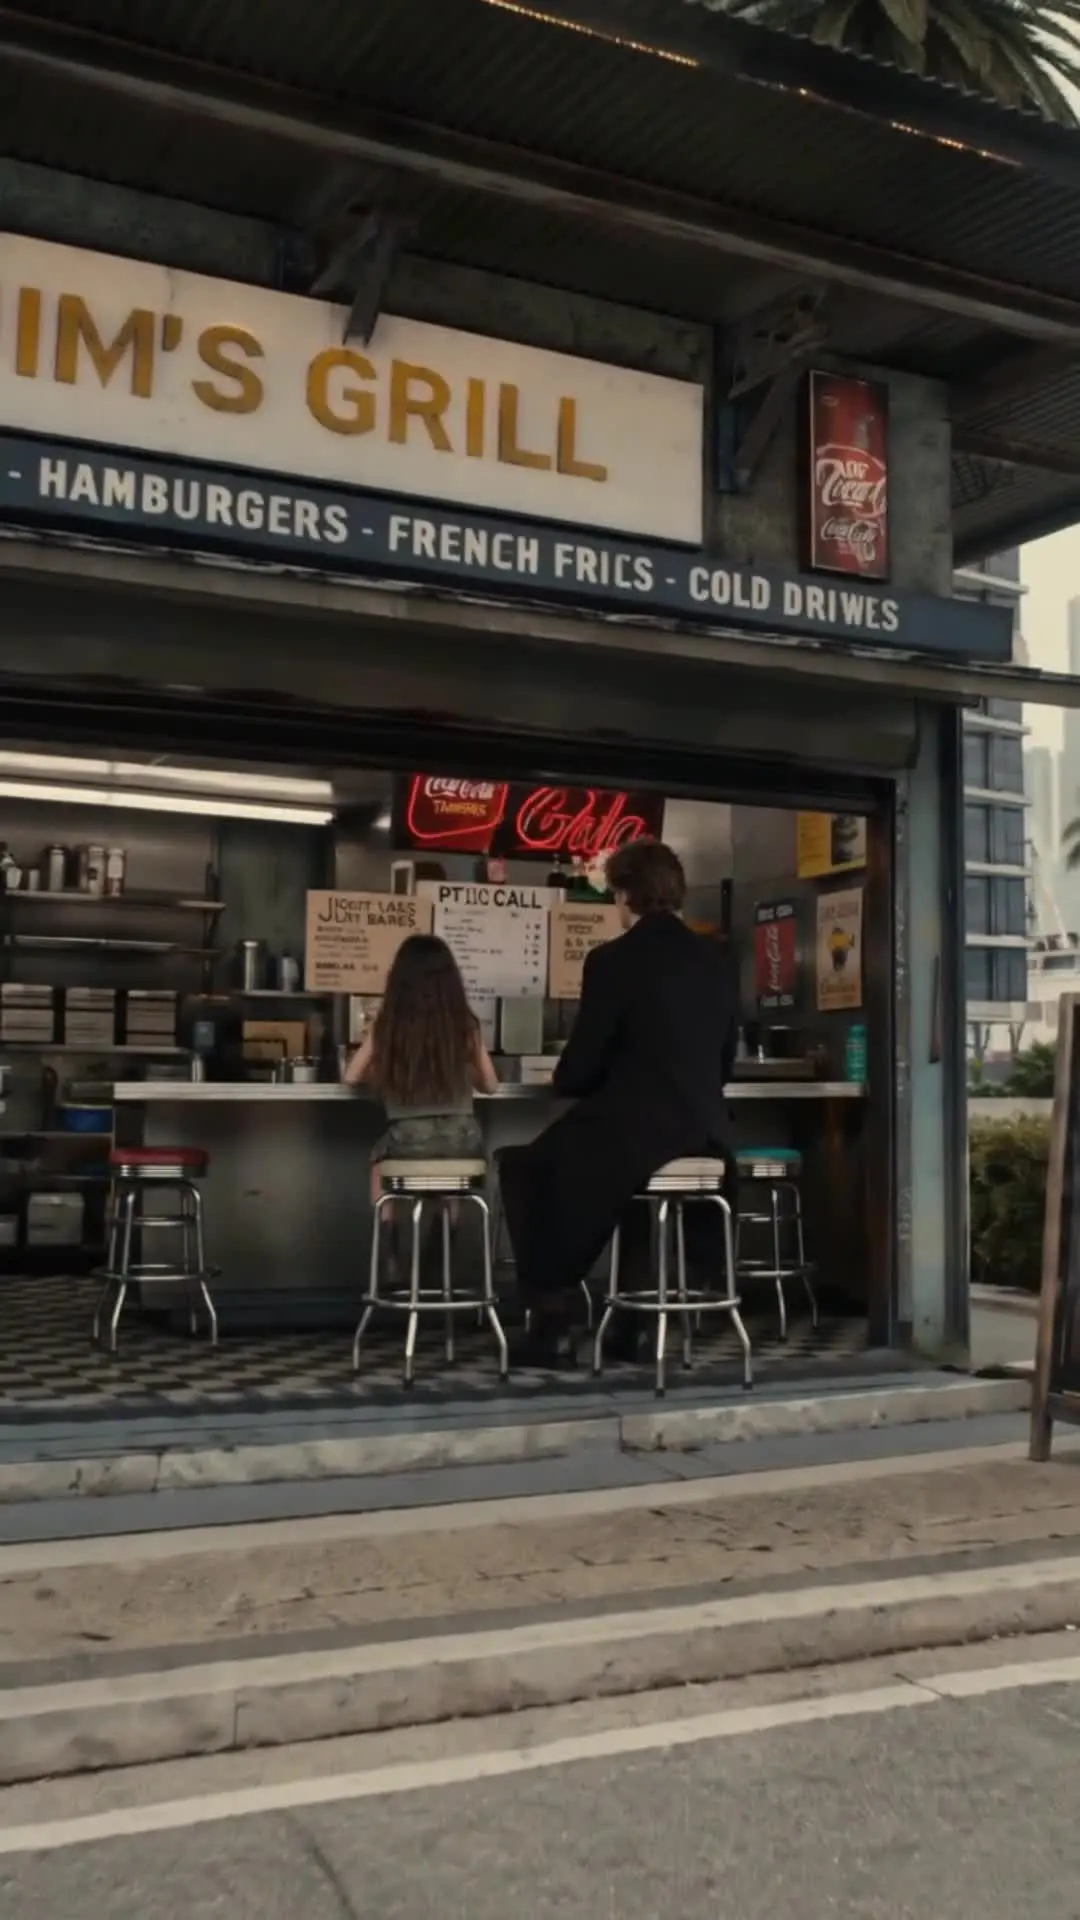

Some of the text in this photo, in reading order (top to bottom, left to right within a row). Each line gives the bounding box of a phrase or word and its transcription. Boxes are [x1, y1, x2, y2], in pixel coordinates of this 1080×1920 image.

[0, 280, 608, 482] IM'S GRILL
[39, 458, 349, 543] HAMBURGERS
[389, 516, 540, 574] FRENCH
[689, 567, 771, 610] COLD
[493, 889, 543, 909] CALL
